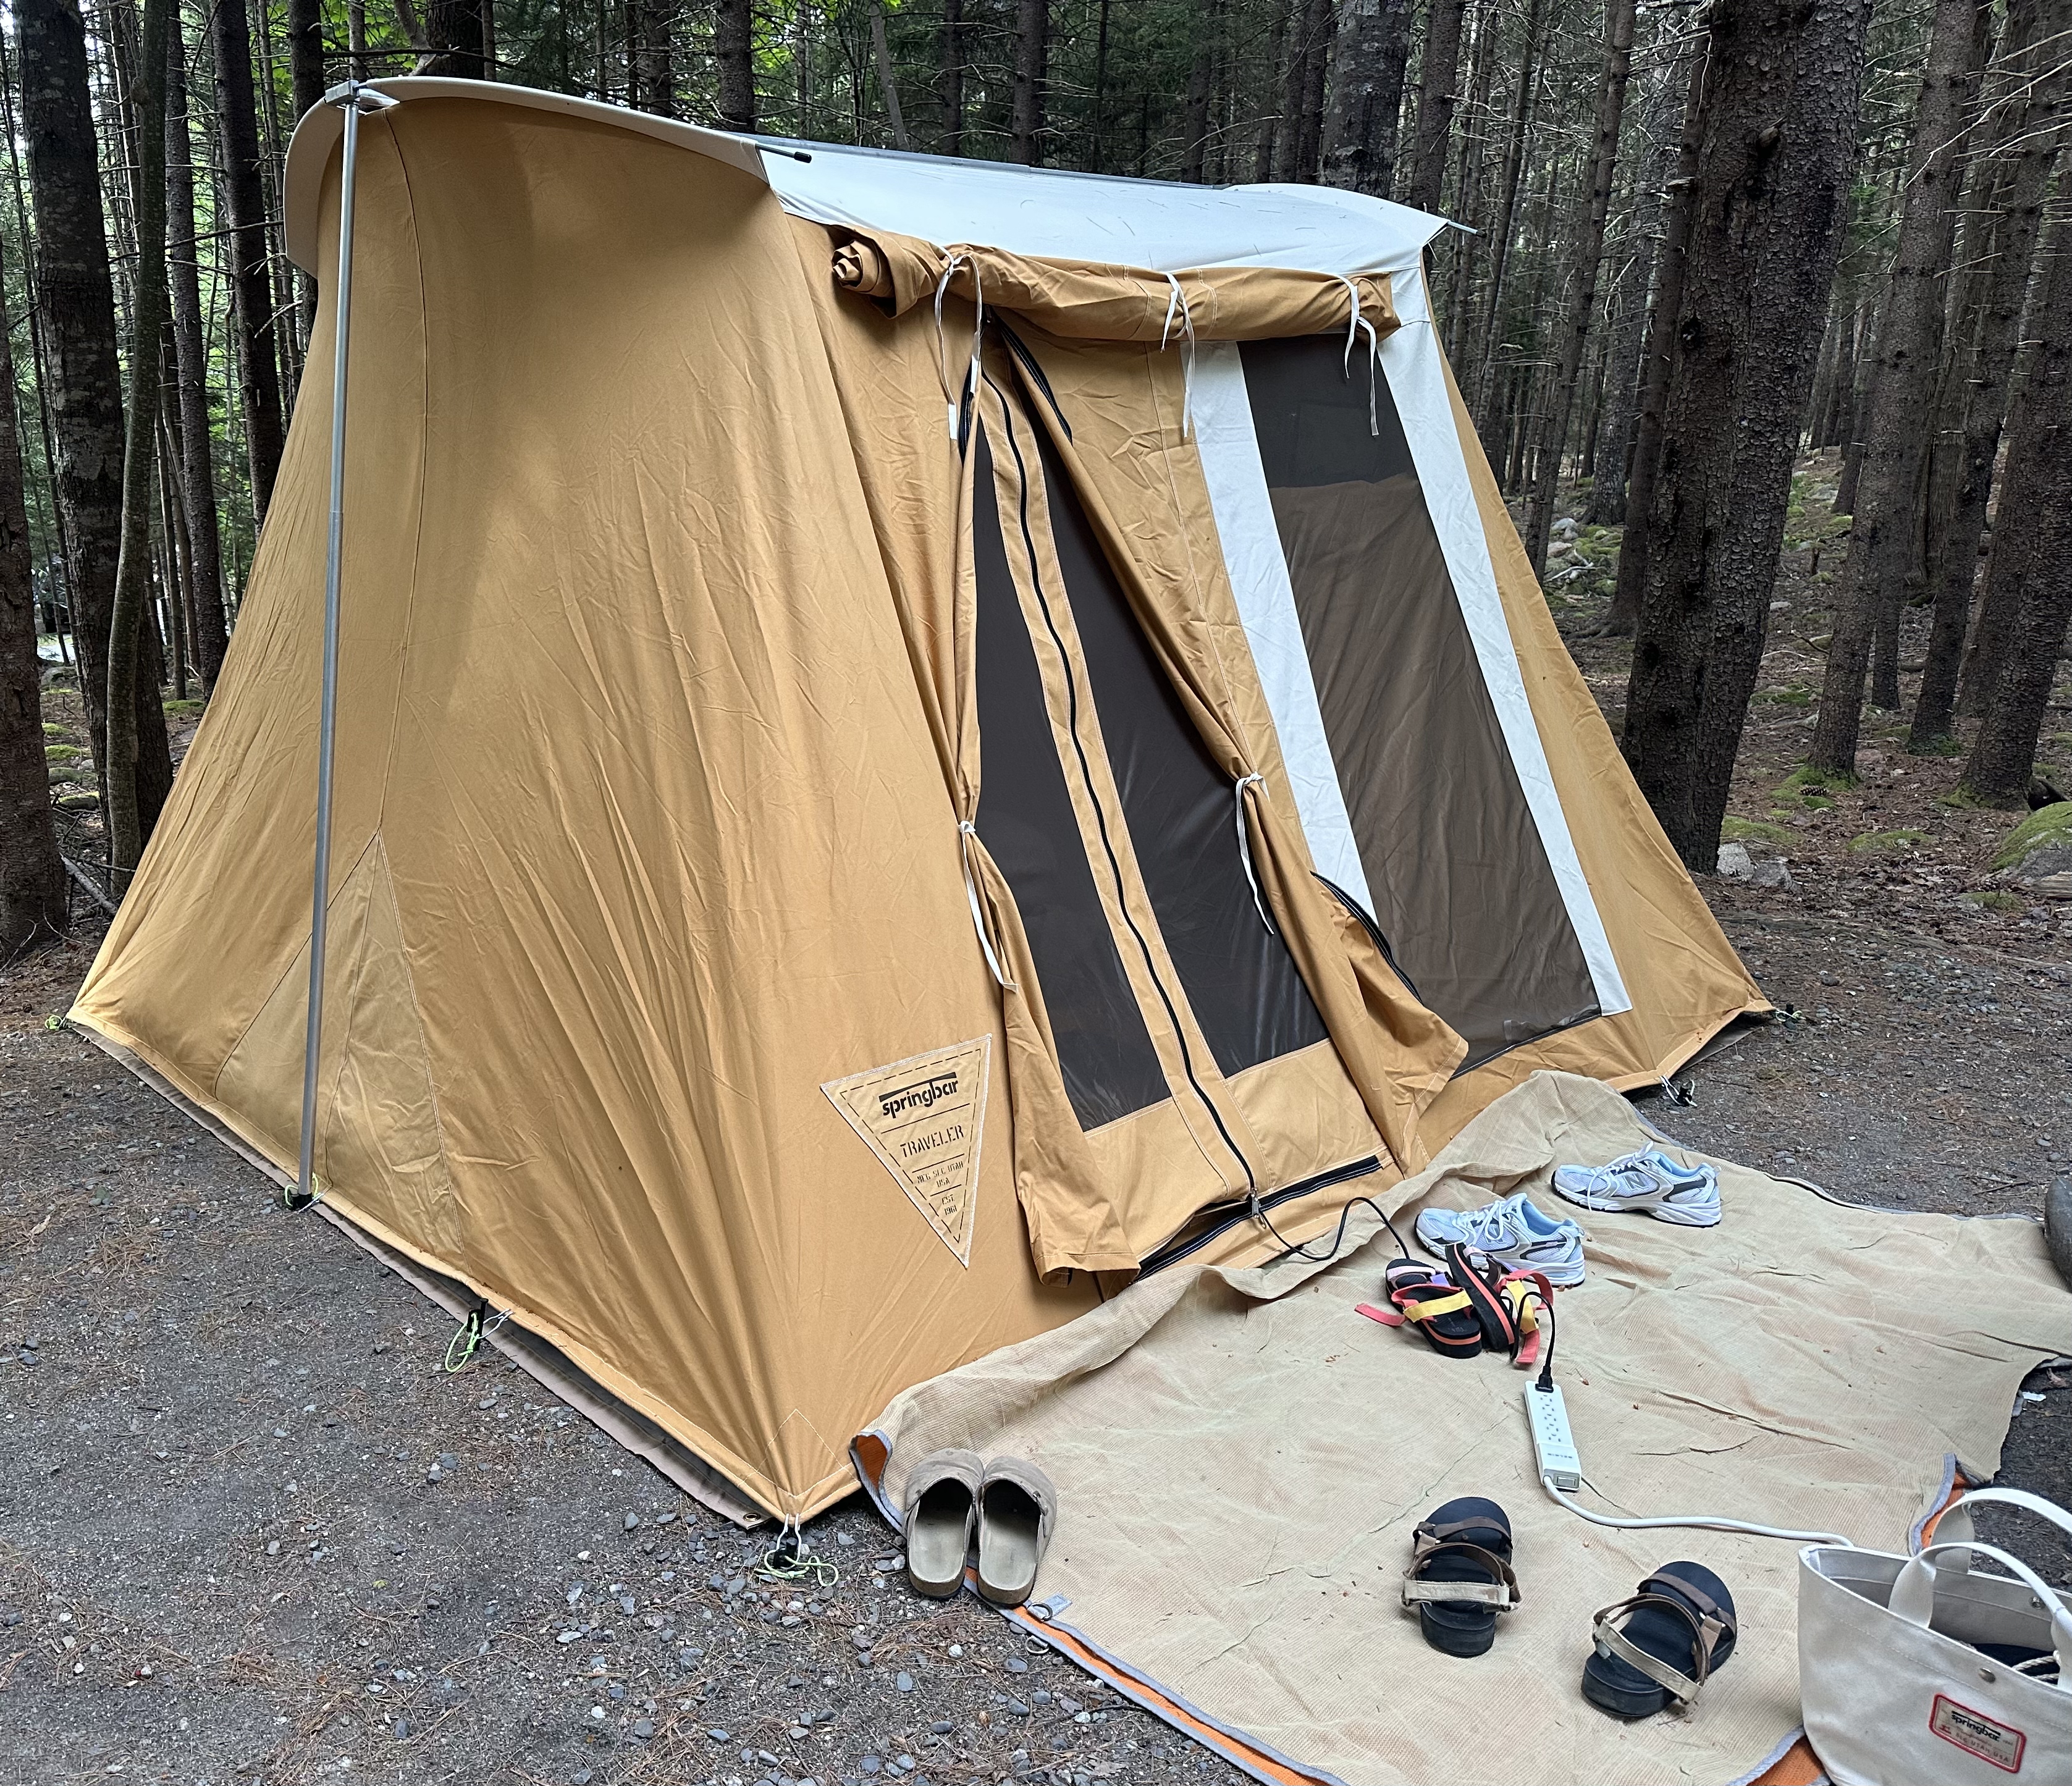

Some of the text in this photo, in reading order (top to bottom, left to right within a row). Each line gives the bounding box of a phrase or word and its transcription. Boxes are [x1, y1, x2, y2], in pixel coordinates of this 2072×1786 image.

[882, 1079, 958, 1119] springbar
[899, 1124, 964, 1157] TRAVELER
[932, 1167, 946, 1177] SLC
[947, 1160, 964, 1172] UTAH
[936, 1177, 950, 1187] USA
[944, 1204, 958, 1216] 1961
[1951, 1712, 2001, 1742] springbar
[1993, 1751, 2009, 1763] USA
